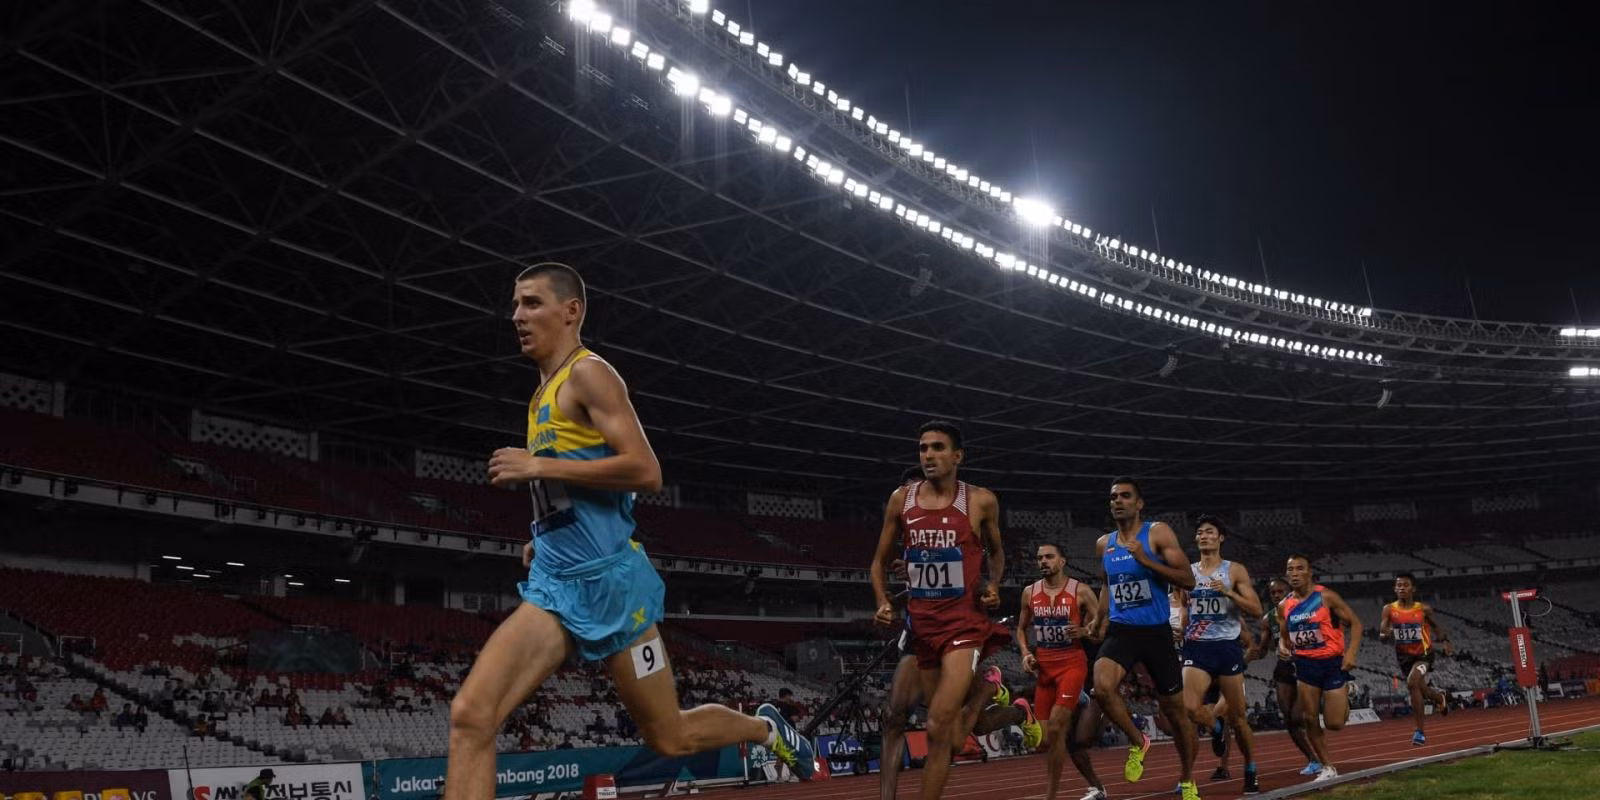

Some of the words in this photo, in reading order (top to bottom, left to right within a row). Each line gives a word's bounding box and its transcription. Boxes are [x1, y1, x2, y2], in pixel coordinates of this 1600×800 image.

[914, 563, 953, 588] 701
[1115, 582, 1144, 602] 432
[1033, 605, 1071, 617] BAHRAIN
[1196, 598, 1220, 614] 570
[1039, 626, 1064, 642] 138
[1295, 631, 1317, 645] 633
[1398, 628, 1417, 640] 812
[642, 645, 655, 671] 9
[391, 775, 446, 793] Jakar
[496, 768, 545, 785] mbang
[547, 763, 580, 780] 2018
